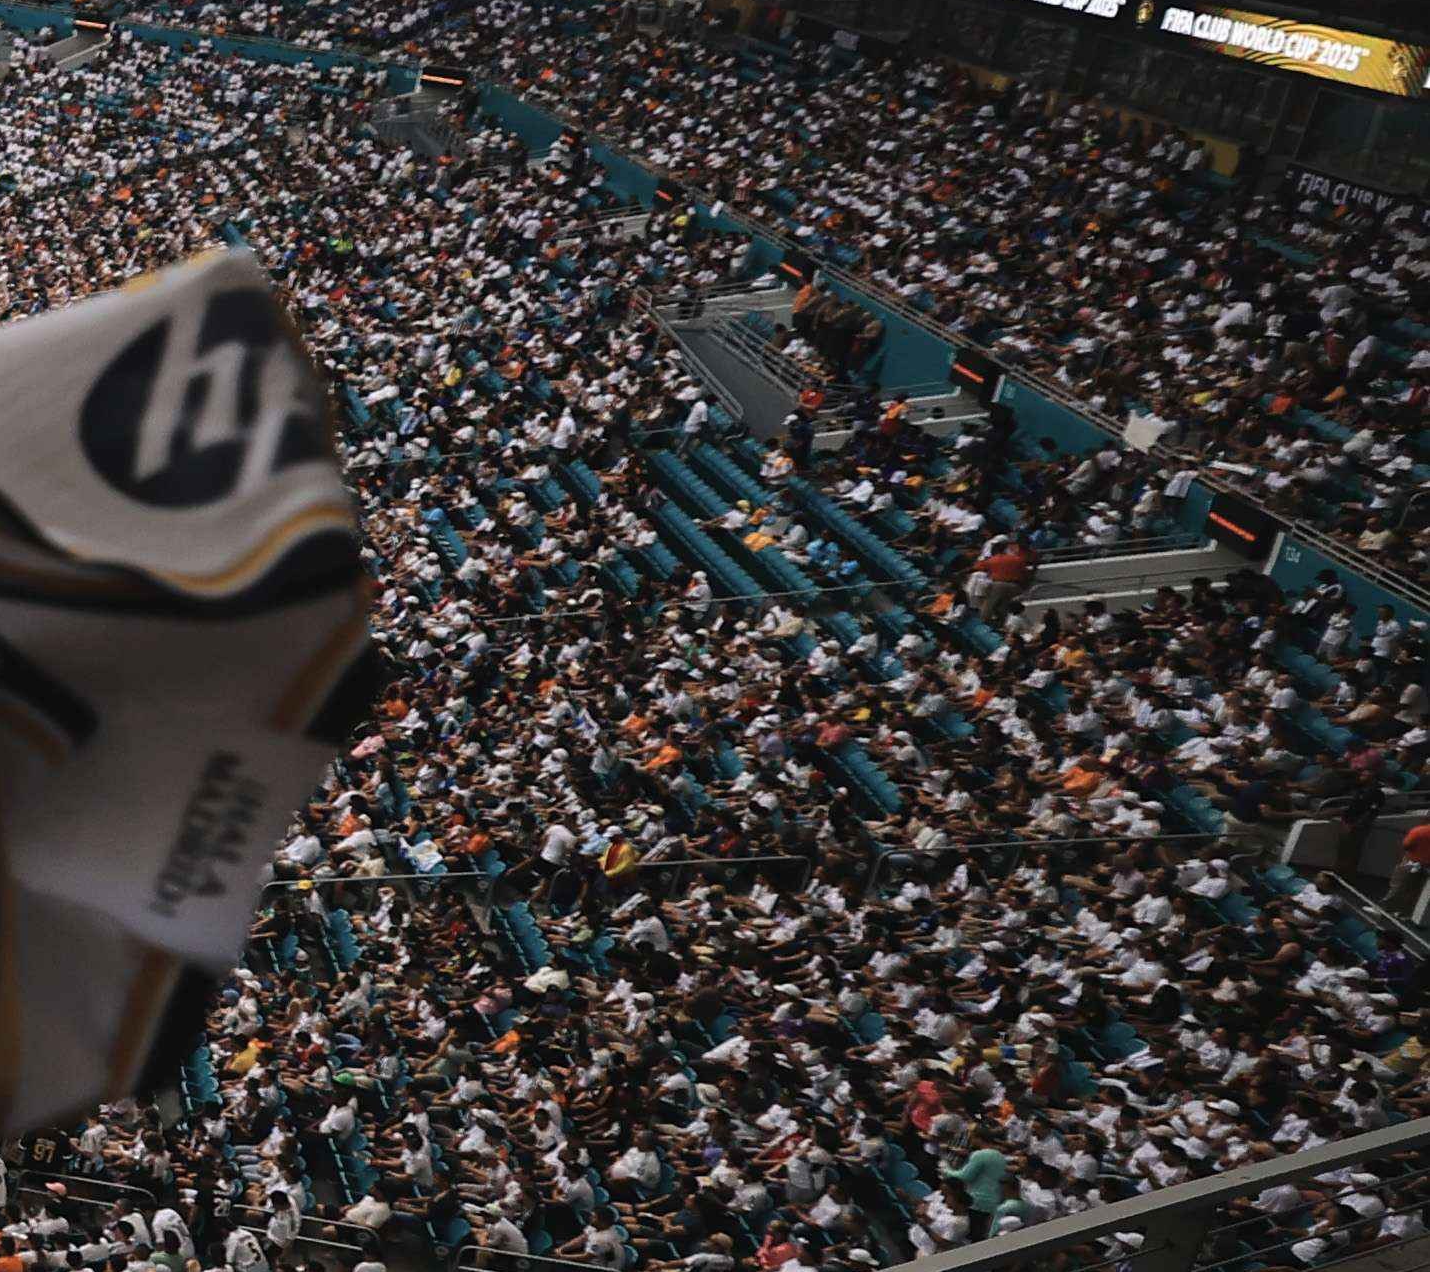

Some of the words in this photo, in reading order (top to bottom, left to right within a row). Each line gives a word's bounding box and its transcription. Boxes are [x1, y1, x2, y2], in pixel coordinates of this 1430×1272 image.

[1161, 7, 1195, 36] FIFA
[1194, 14, 1232, 44] CLUB
[1232, 20, 1286, 54] WORLD
[1282, 31, 1320, 62] CUP
